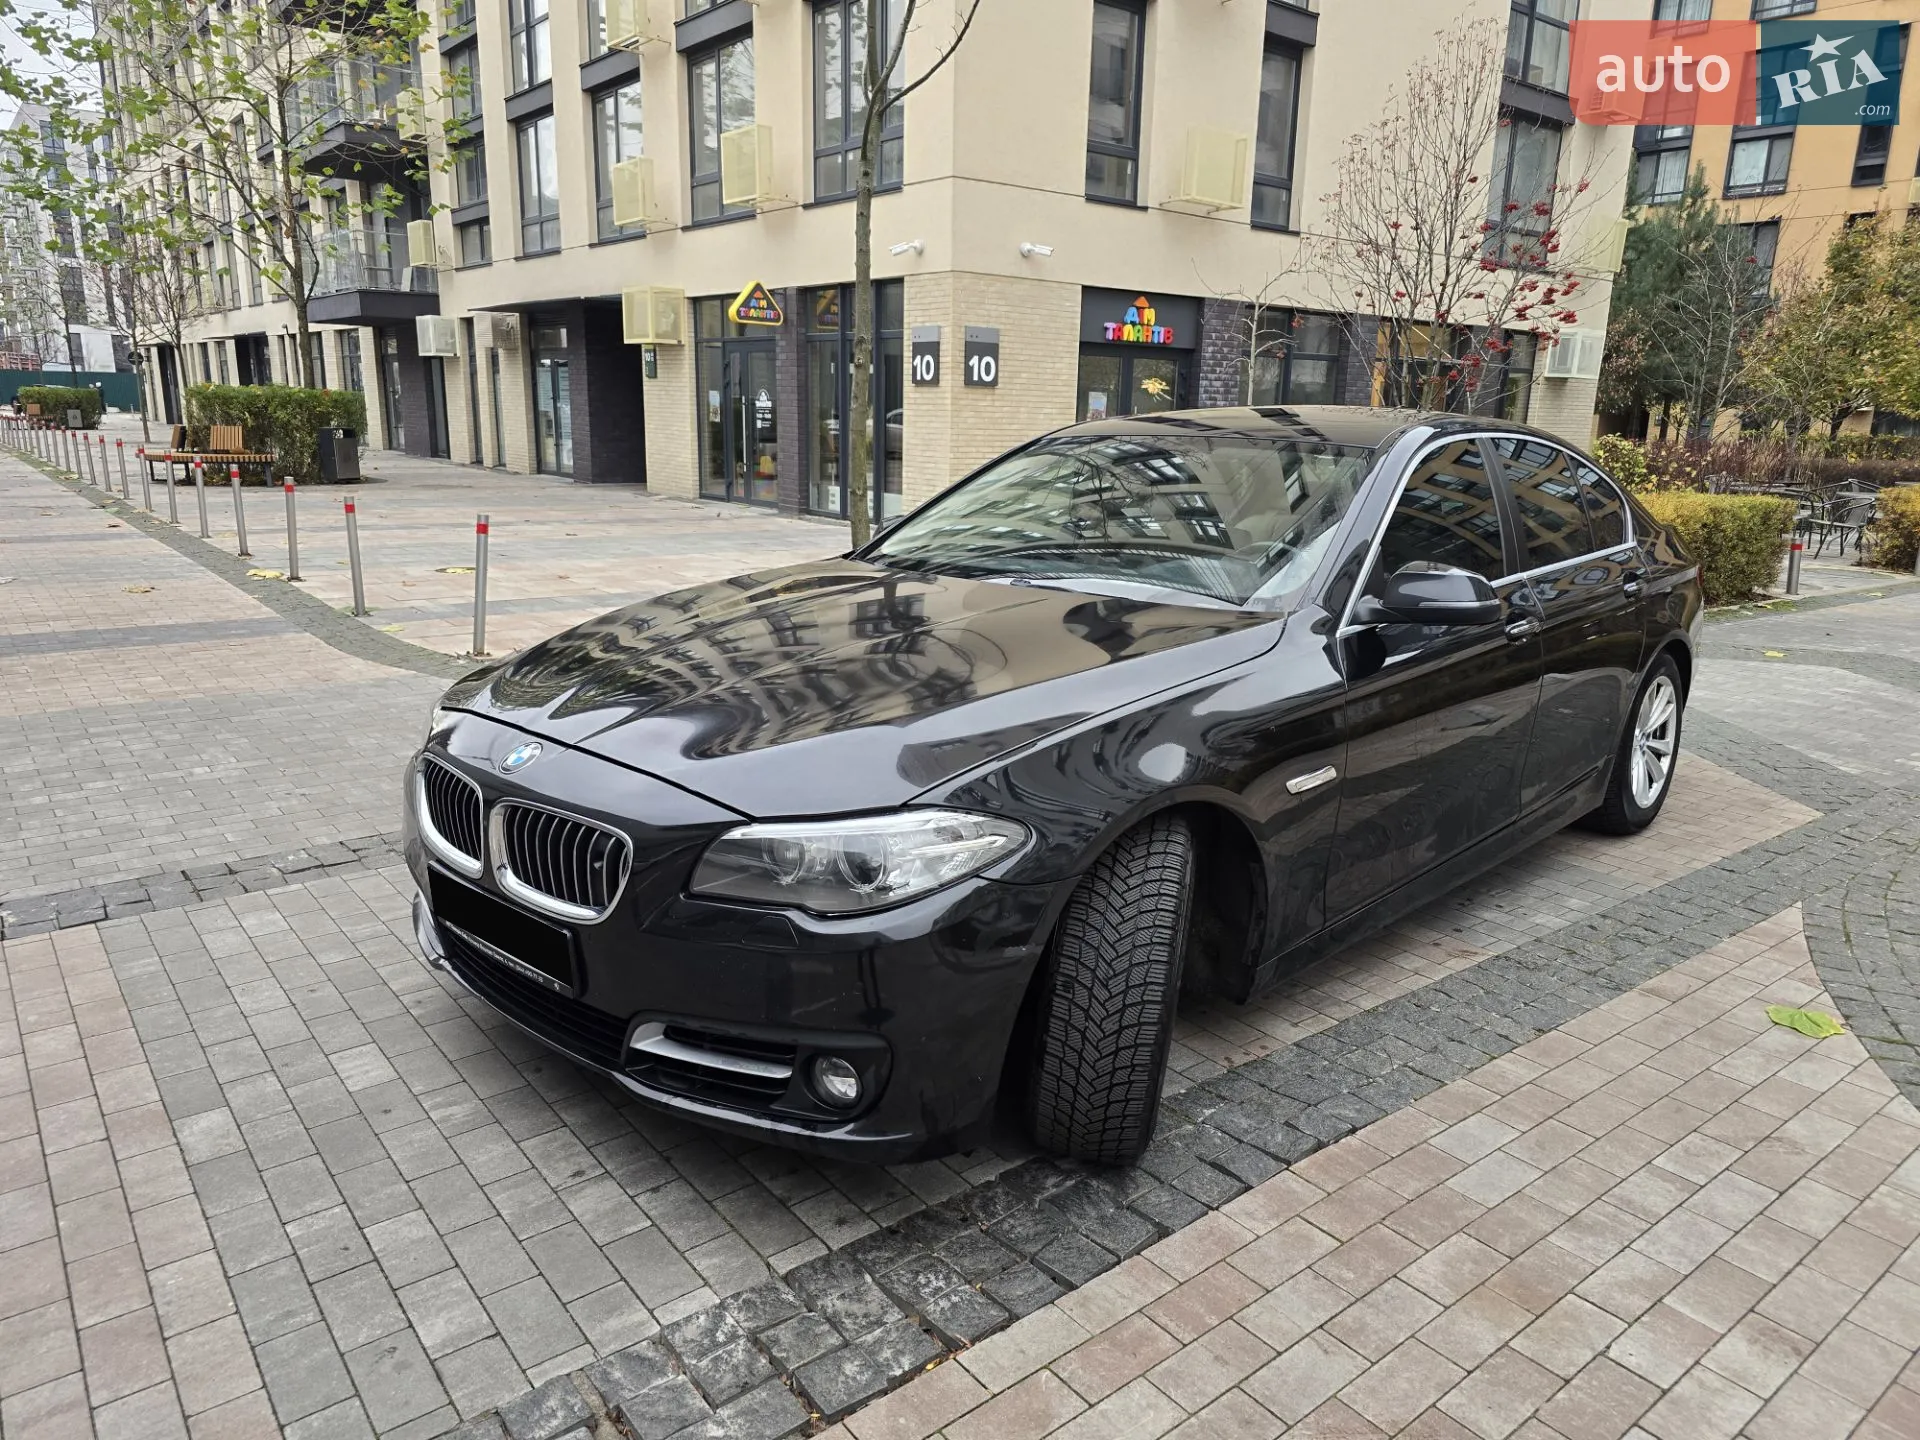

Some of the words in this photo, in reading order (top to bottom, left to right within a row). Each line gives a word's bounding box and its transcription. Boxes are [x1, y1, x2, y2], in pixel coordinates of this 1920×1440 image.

[1103, 321, 1174, 344] ТАЛАНТІВ
[913, 354, 935, 381] 10
[968, 355, 996, 382] 10
